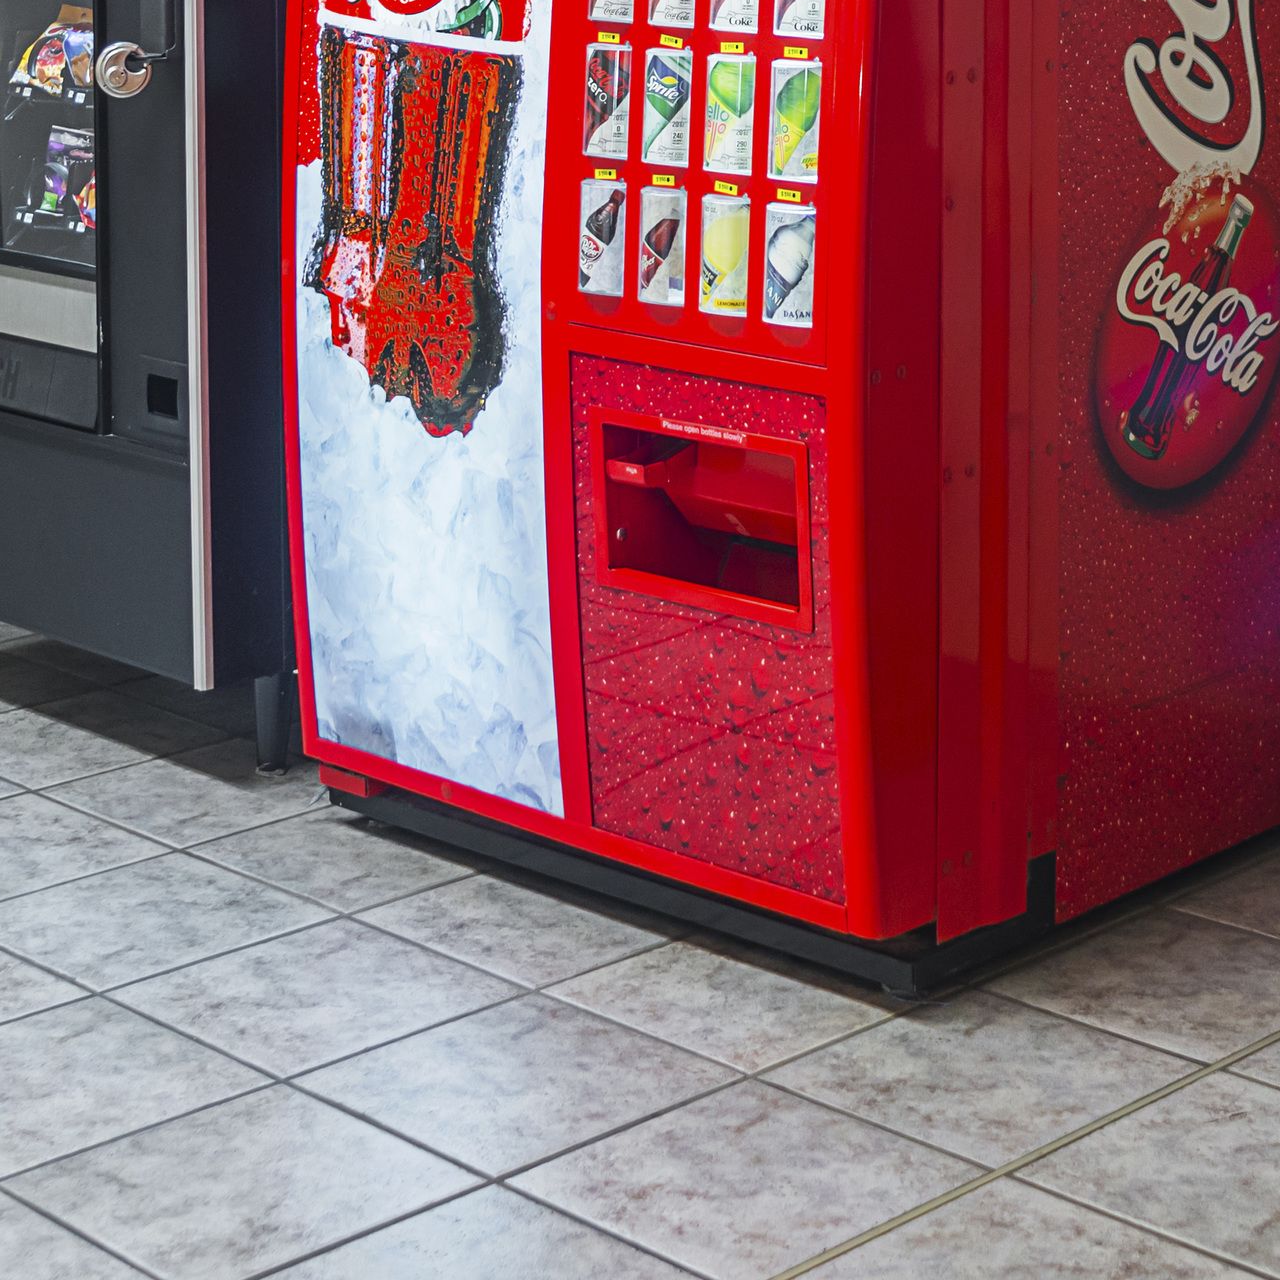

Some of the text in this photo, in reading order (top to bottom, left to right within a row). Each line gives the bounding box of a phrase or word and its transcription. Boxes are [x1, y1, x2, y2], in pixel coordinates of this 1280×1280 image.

[728, 16, 753, 26] Coke
[794, 21, 818, 32] Coke
[647, 74, 680, 100] Sprite
[672, 132, 684, 140] 240
[1116, 237, 1280, 394] Coca-Cola
[662, 420, 683, 431] Please
[684, 425, 700, 434] open
